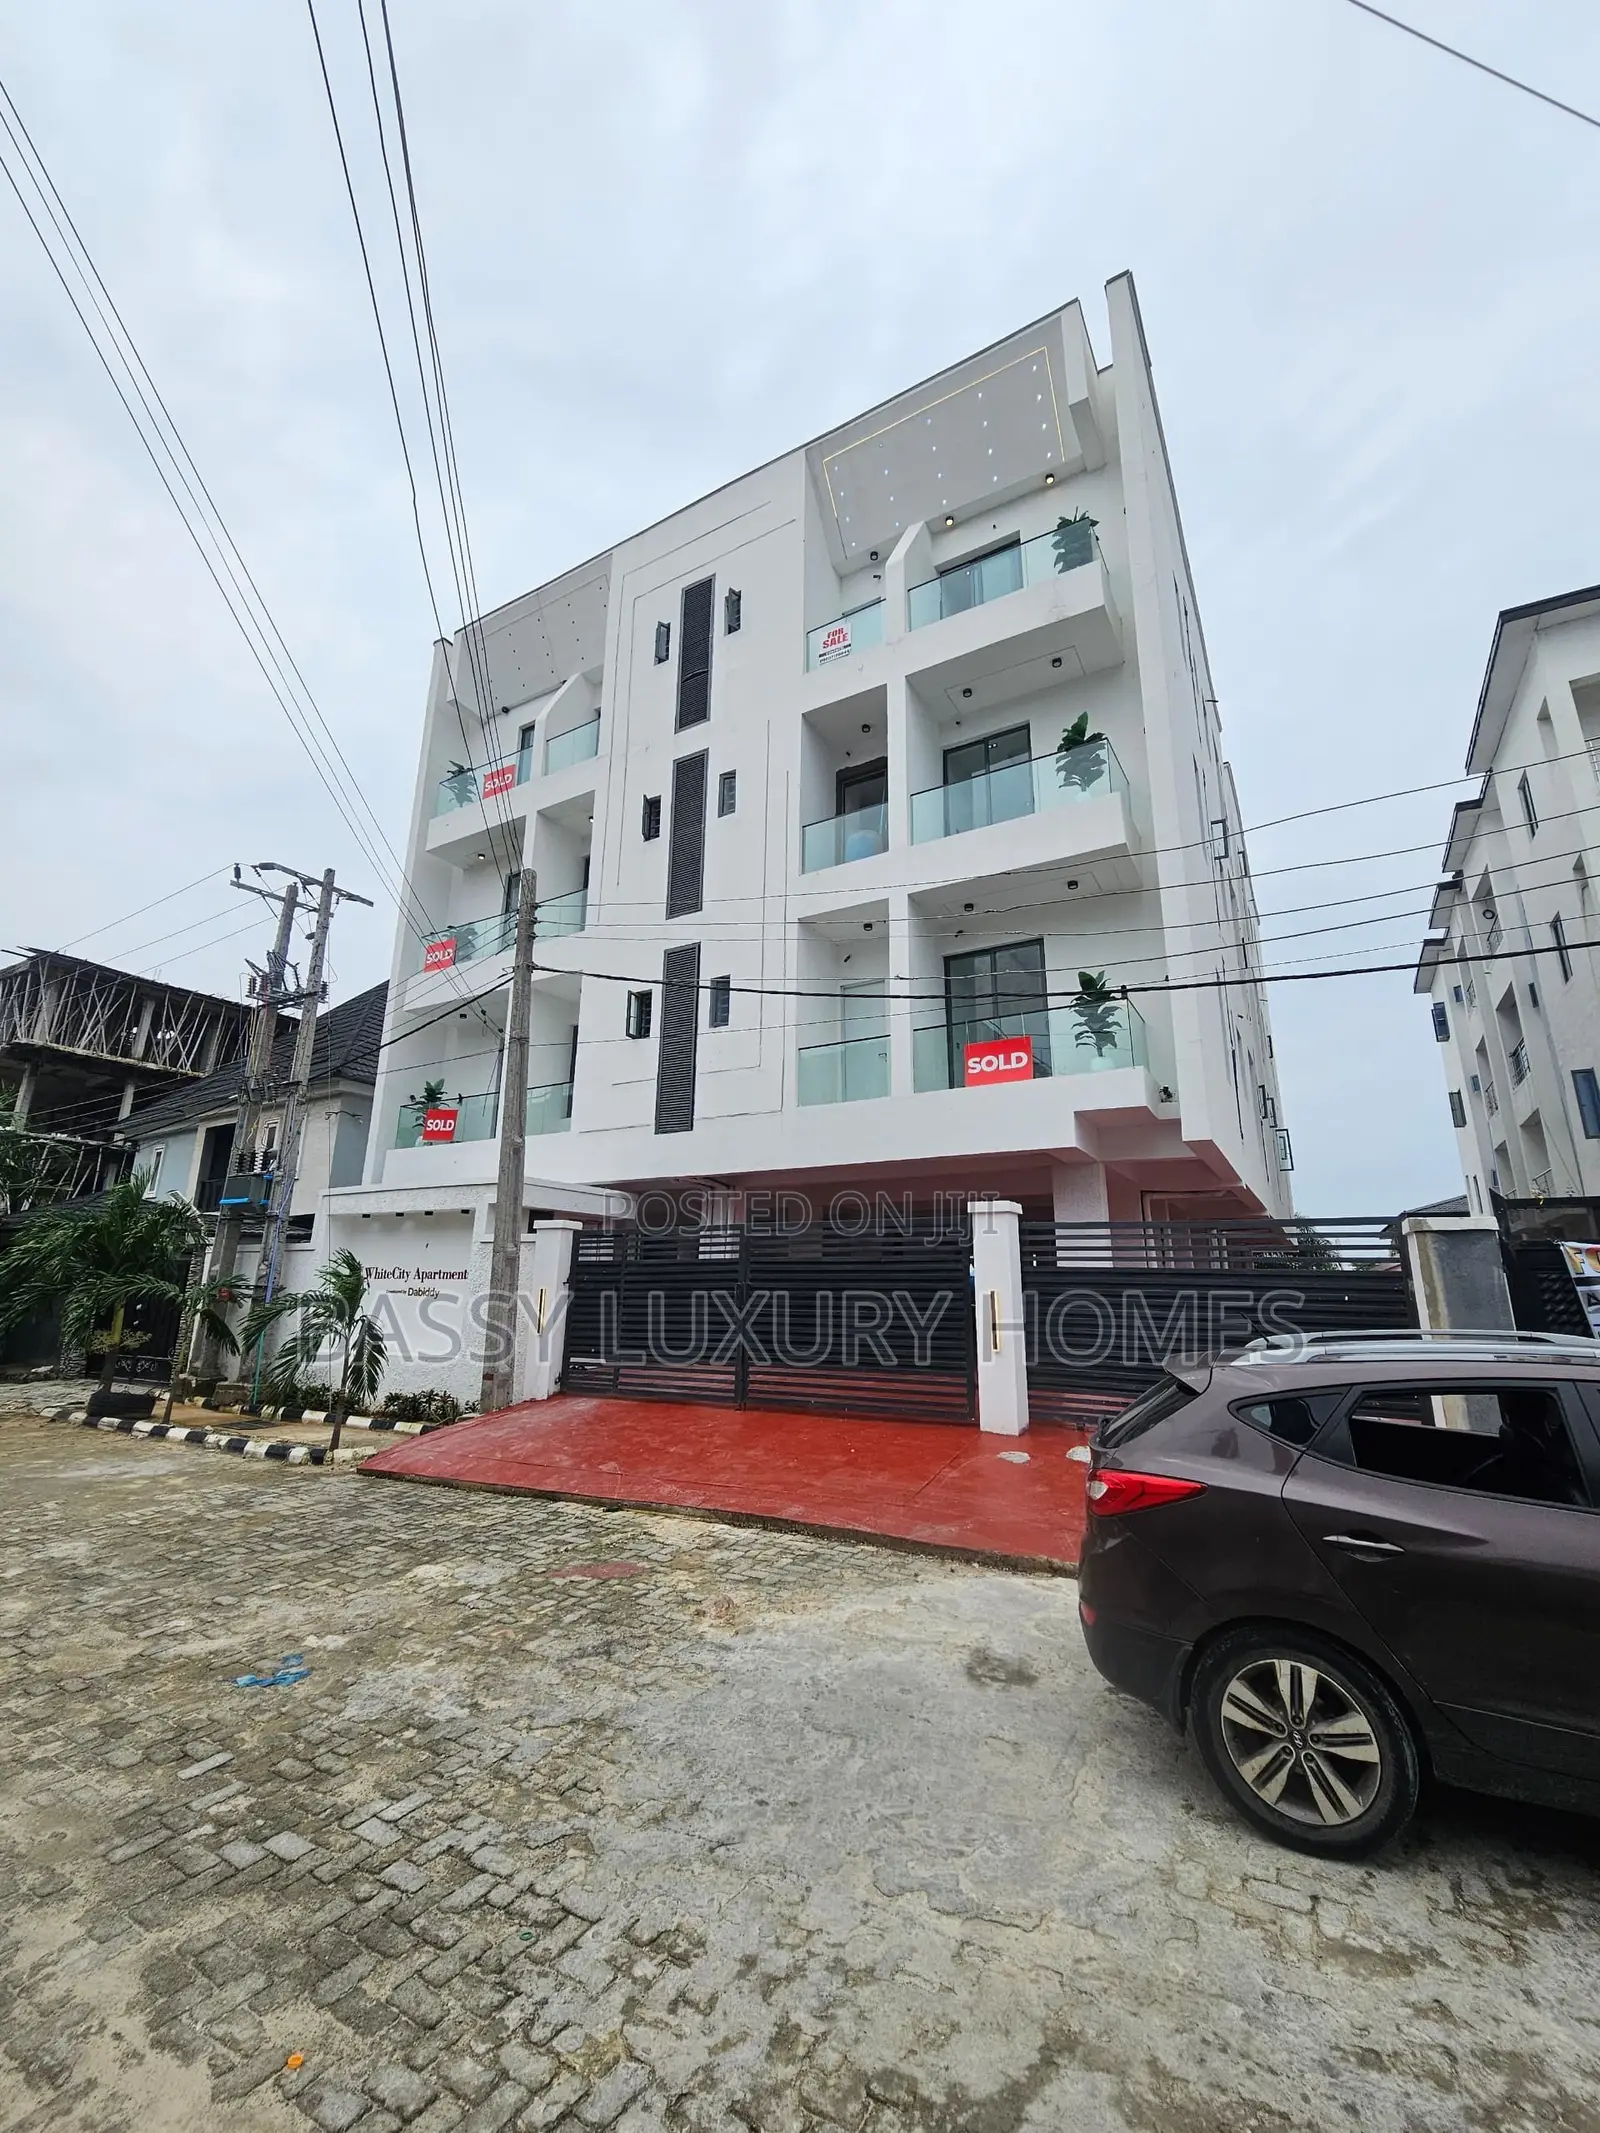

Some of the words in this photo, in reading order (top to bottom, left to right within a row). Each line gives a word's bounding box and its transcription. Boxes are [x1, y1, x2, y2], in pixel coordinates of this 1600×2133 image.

[822, 632, 849, 649] SALE
[827, 627, 844, 639] FOR
[485, 774, 512, 792] SOLD
[426, 948, 453, 964] SOLD
[967, 1051, 1028, 1074] SOLD
[426, 1119, 455, 1131] SOLD
[364, 1266, 411, 1283] WhiteCity
[413, 1267, 469, 1283] Apartment
[407, 1287, 440, 1300] Dabiddy
